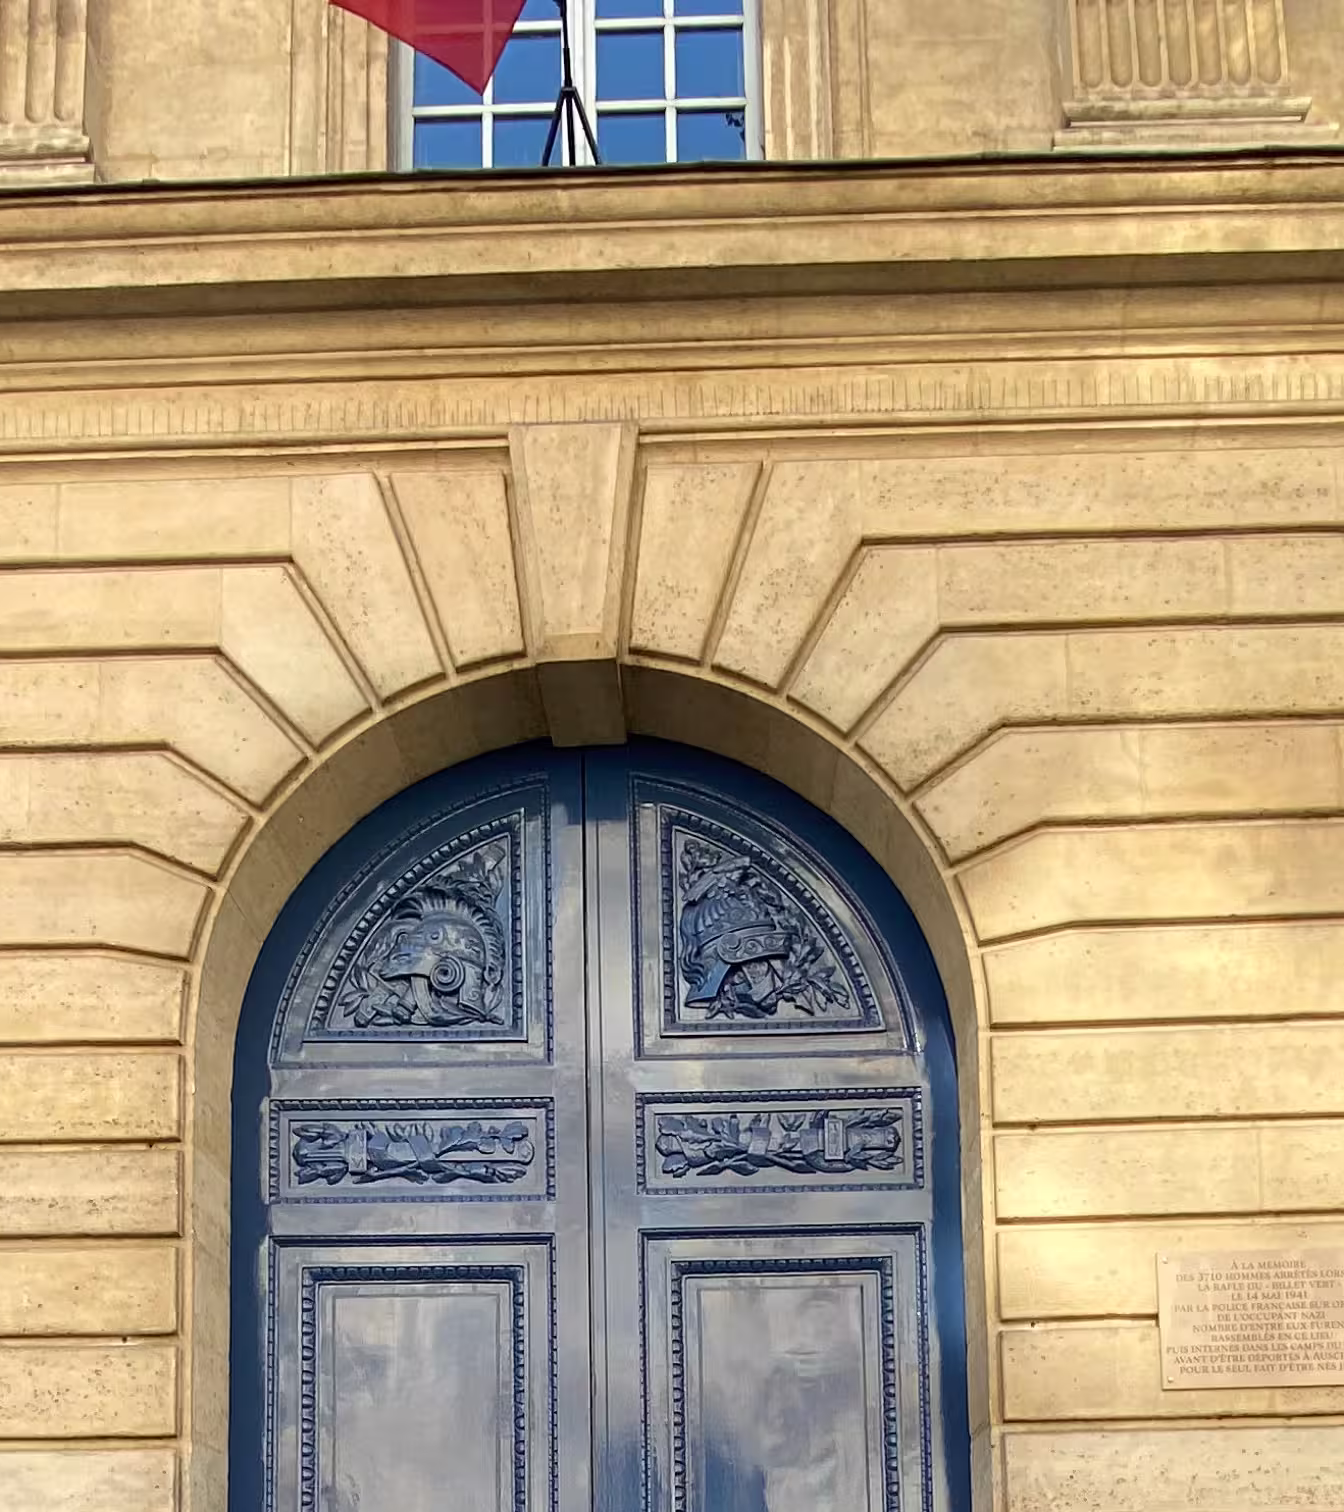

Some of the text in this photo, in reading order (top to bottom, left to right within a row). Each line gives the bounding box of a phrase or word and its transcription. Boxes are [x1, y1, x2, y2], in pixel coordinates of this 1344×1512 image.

[1242, 1262, 1254, 1270] LA
[1176, 1273, 1195, 1282] DES
[1225, 1271, 1271, 1282] HOMMES
[1198, 1280, 1335, 1292] LA RAFLE DU BILLET VERT
[1231, 1290, 1307, 1301] LE 14 MAI 1941
[1174, 1304, 1194, 1313] PAR
[1196, 1304, 1210, 1313] LA
[1212, 1302, 1248, 1312] POLICE
[1309, 1300, 1329, 1309] SUR
[1217, 1314, 1231, 1322] DE
[1300, 1311, 1326, 1320] NAZI
[1192, 1324, 1238, 1333] NOMBRE
[1286, 1321, 1307, 1331] EUX
[1211, 1331, 1334, 1342] RASSEMBLÉS EN CE LIEU
[1166, 1346, 1188, 1354] PUIS
[1242, 1343, 1268, 1352] DANS
[1271, 1342, 1288, 1351] LES
[1290, 1342, 1325, 1350] CAMPS
[1327, 1341, 1342, 1350] DU
[1174, 1355, 1206, 1364] AVANT
[1180, 1365, 1209, 1374] POUR
[1211, 1365, 1223, 1374] LE
[1225, 1364, 1251, 1373] SEUL
[1254, 1363, 1276, 1372] FAIT
